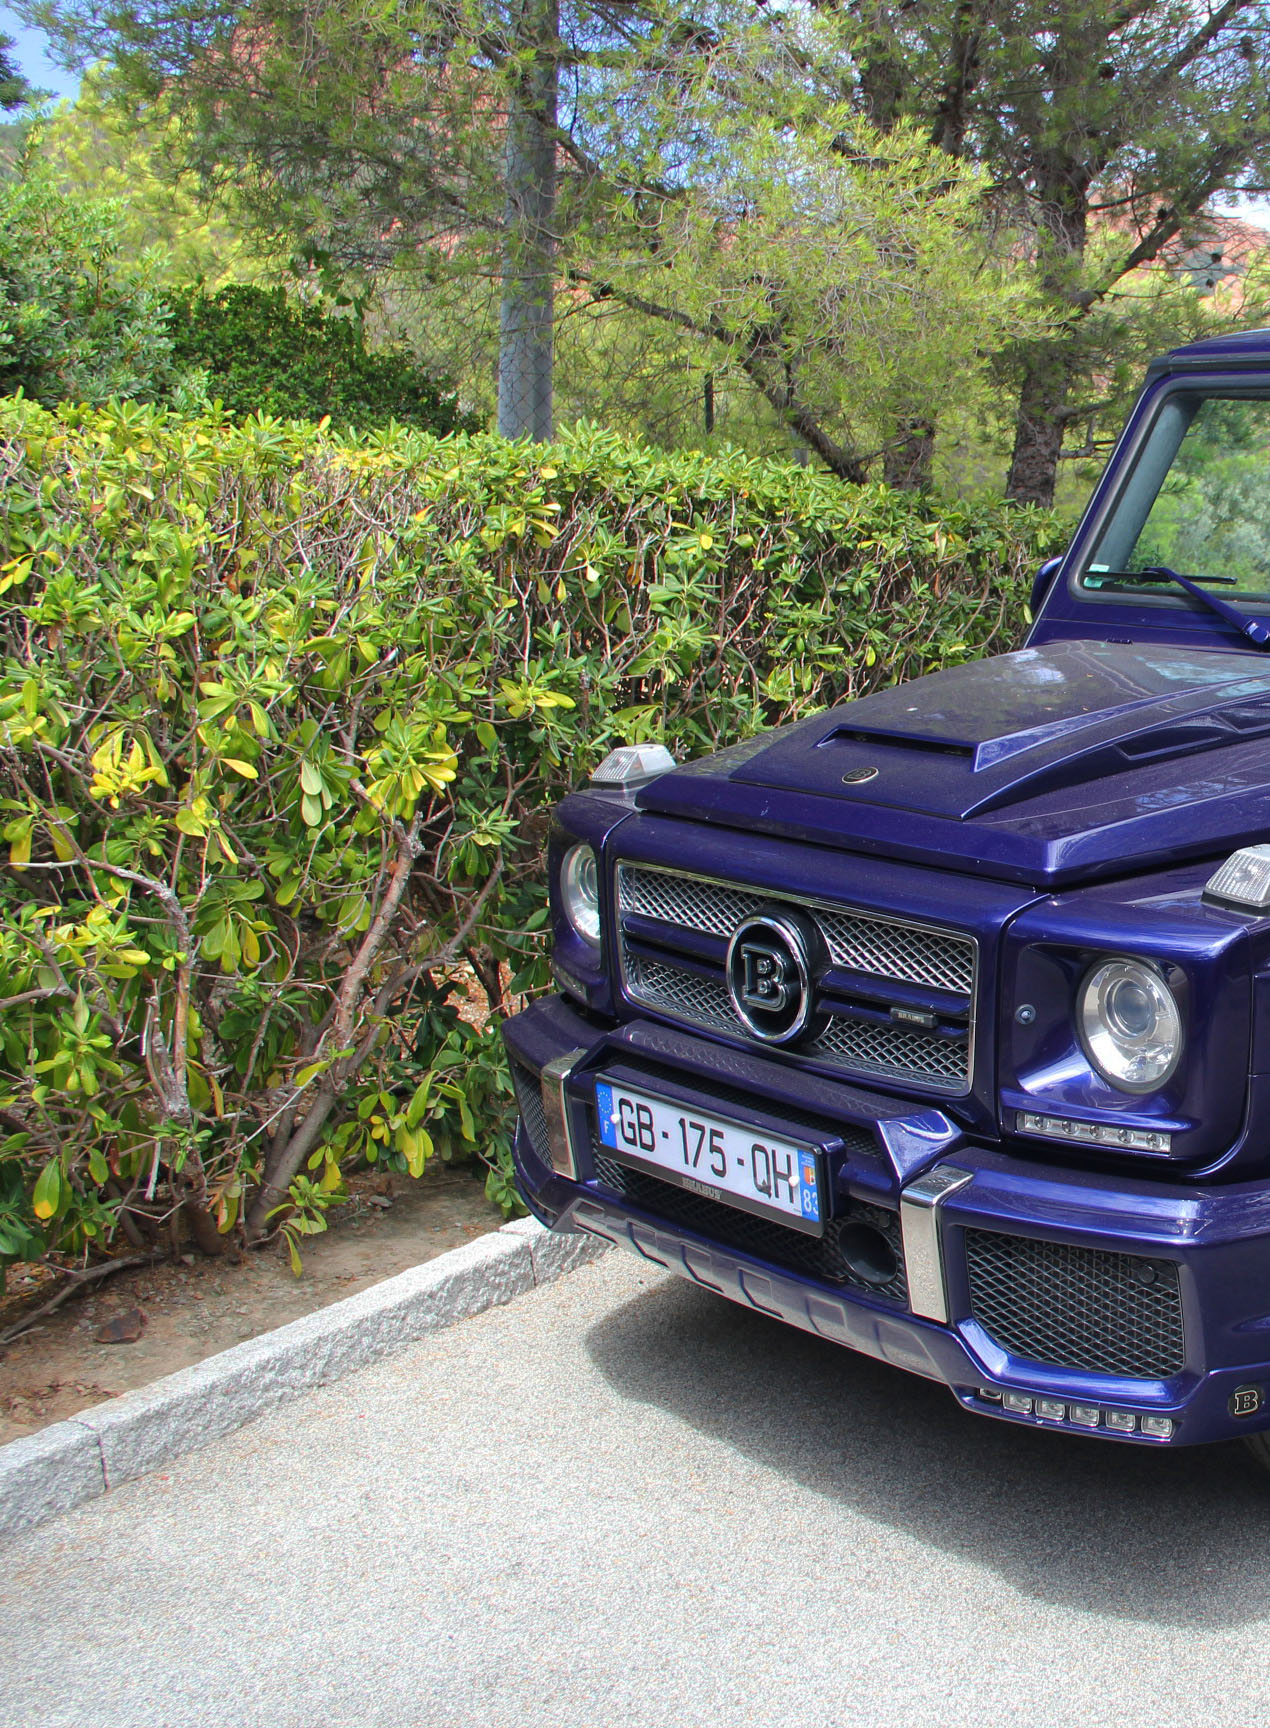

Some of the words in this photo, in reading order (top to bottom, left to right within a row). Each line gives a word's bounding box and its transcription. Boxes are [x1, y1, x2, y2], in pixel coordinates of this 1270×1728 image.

[740, 943, 788, 1013] B
[604, 1120, 609, 1134] F
[803, 1188, 819, 1216] 83
[1234, 1389, 1259, 1415] B
